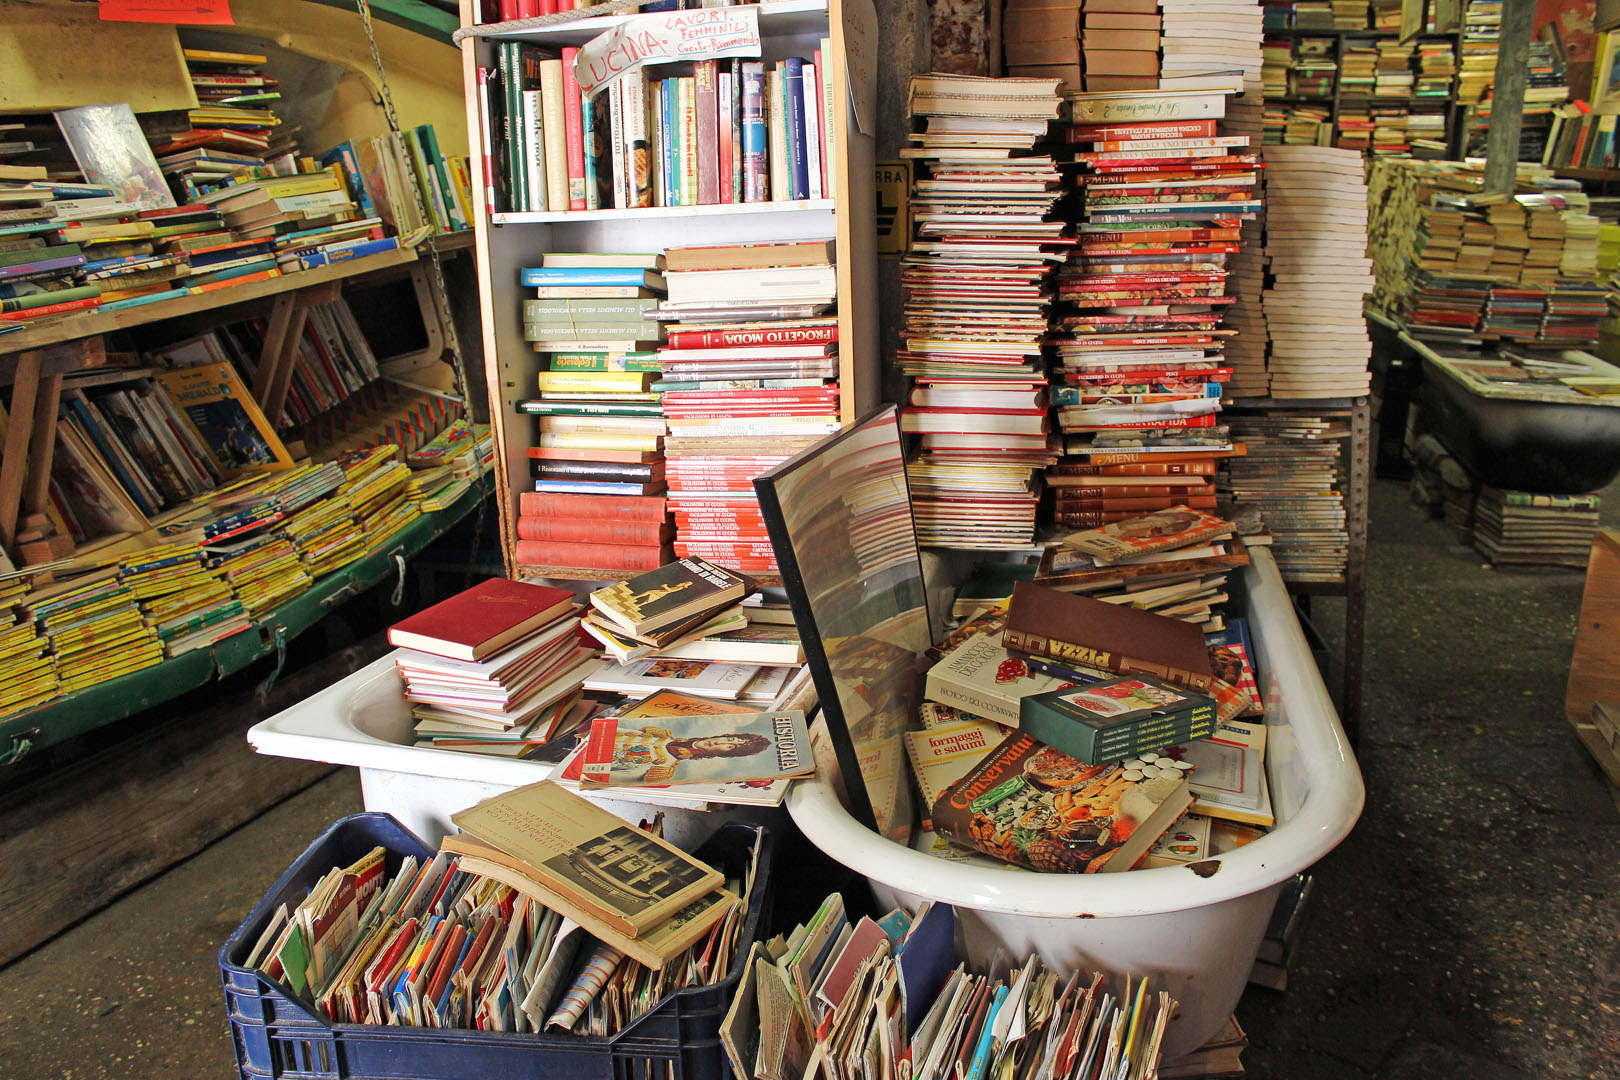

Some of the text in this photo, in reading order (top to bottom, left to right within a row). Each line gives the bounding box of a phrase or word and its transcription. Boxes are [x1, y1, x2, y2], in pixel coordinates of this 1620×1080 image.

[681, 16, 749, 39] FEMMINILI
[1141, 151, 1168, 159] BUONA
[724, 329, 831, 345] PROGETTO MODA
[556, 359, 591, 367] Golosario
[1097, 453, 1139, 465] MENU
[947, 641, 990, 672] ALMANACCO
[960, 645, 1001, 677] DEI GOLOSI
[1049, 639, 1112, 668] PIZZA
[940, 687, 968, 703] GOLOSI
[967, 696, 981, 707] DEI
[776, 716, 800, 771] HISTORIA
[928, 727, 983, 748] formaggi
[933, 738, 987, 756] e salumi
